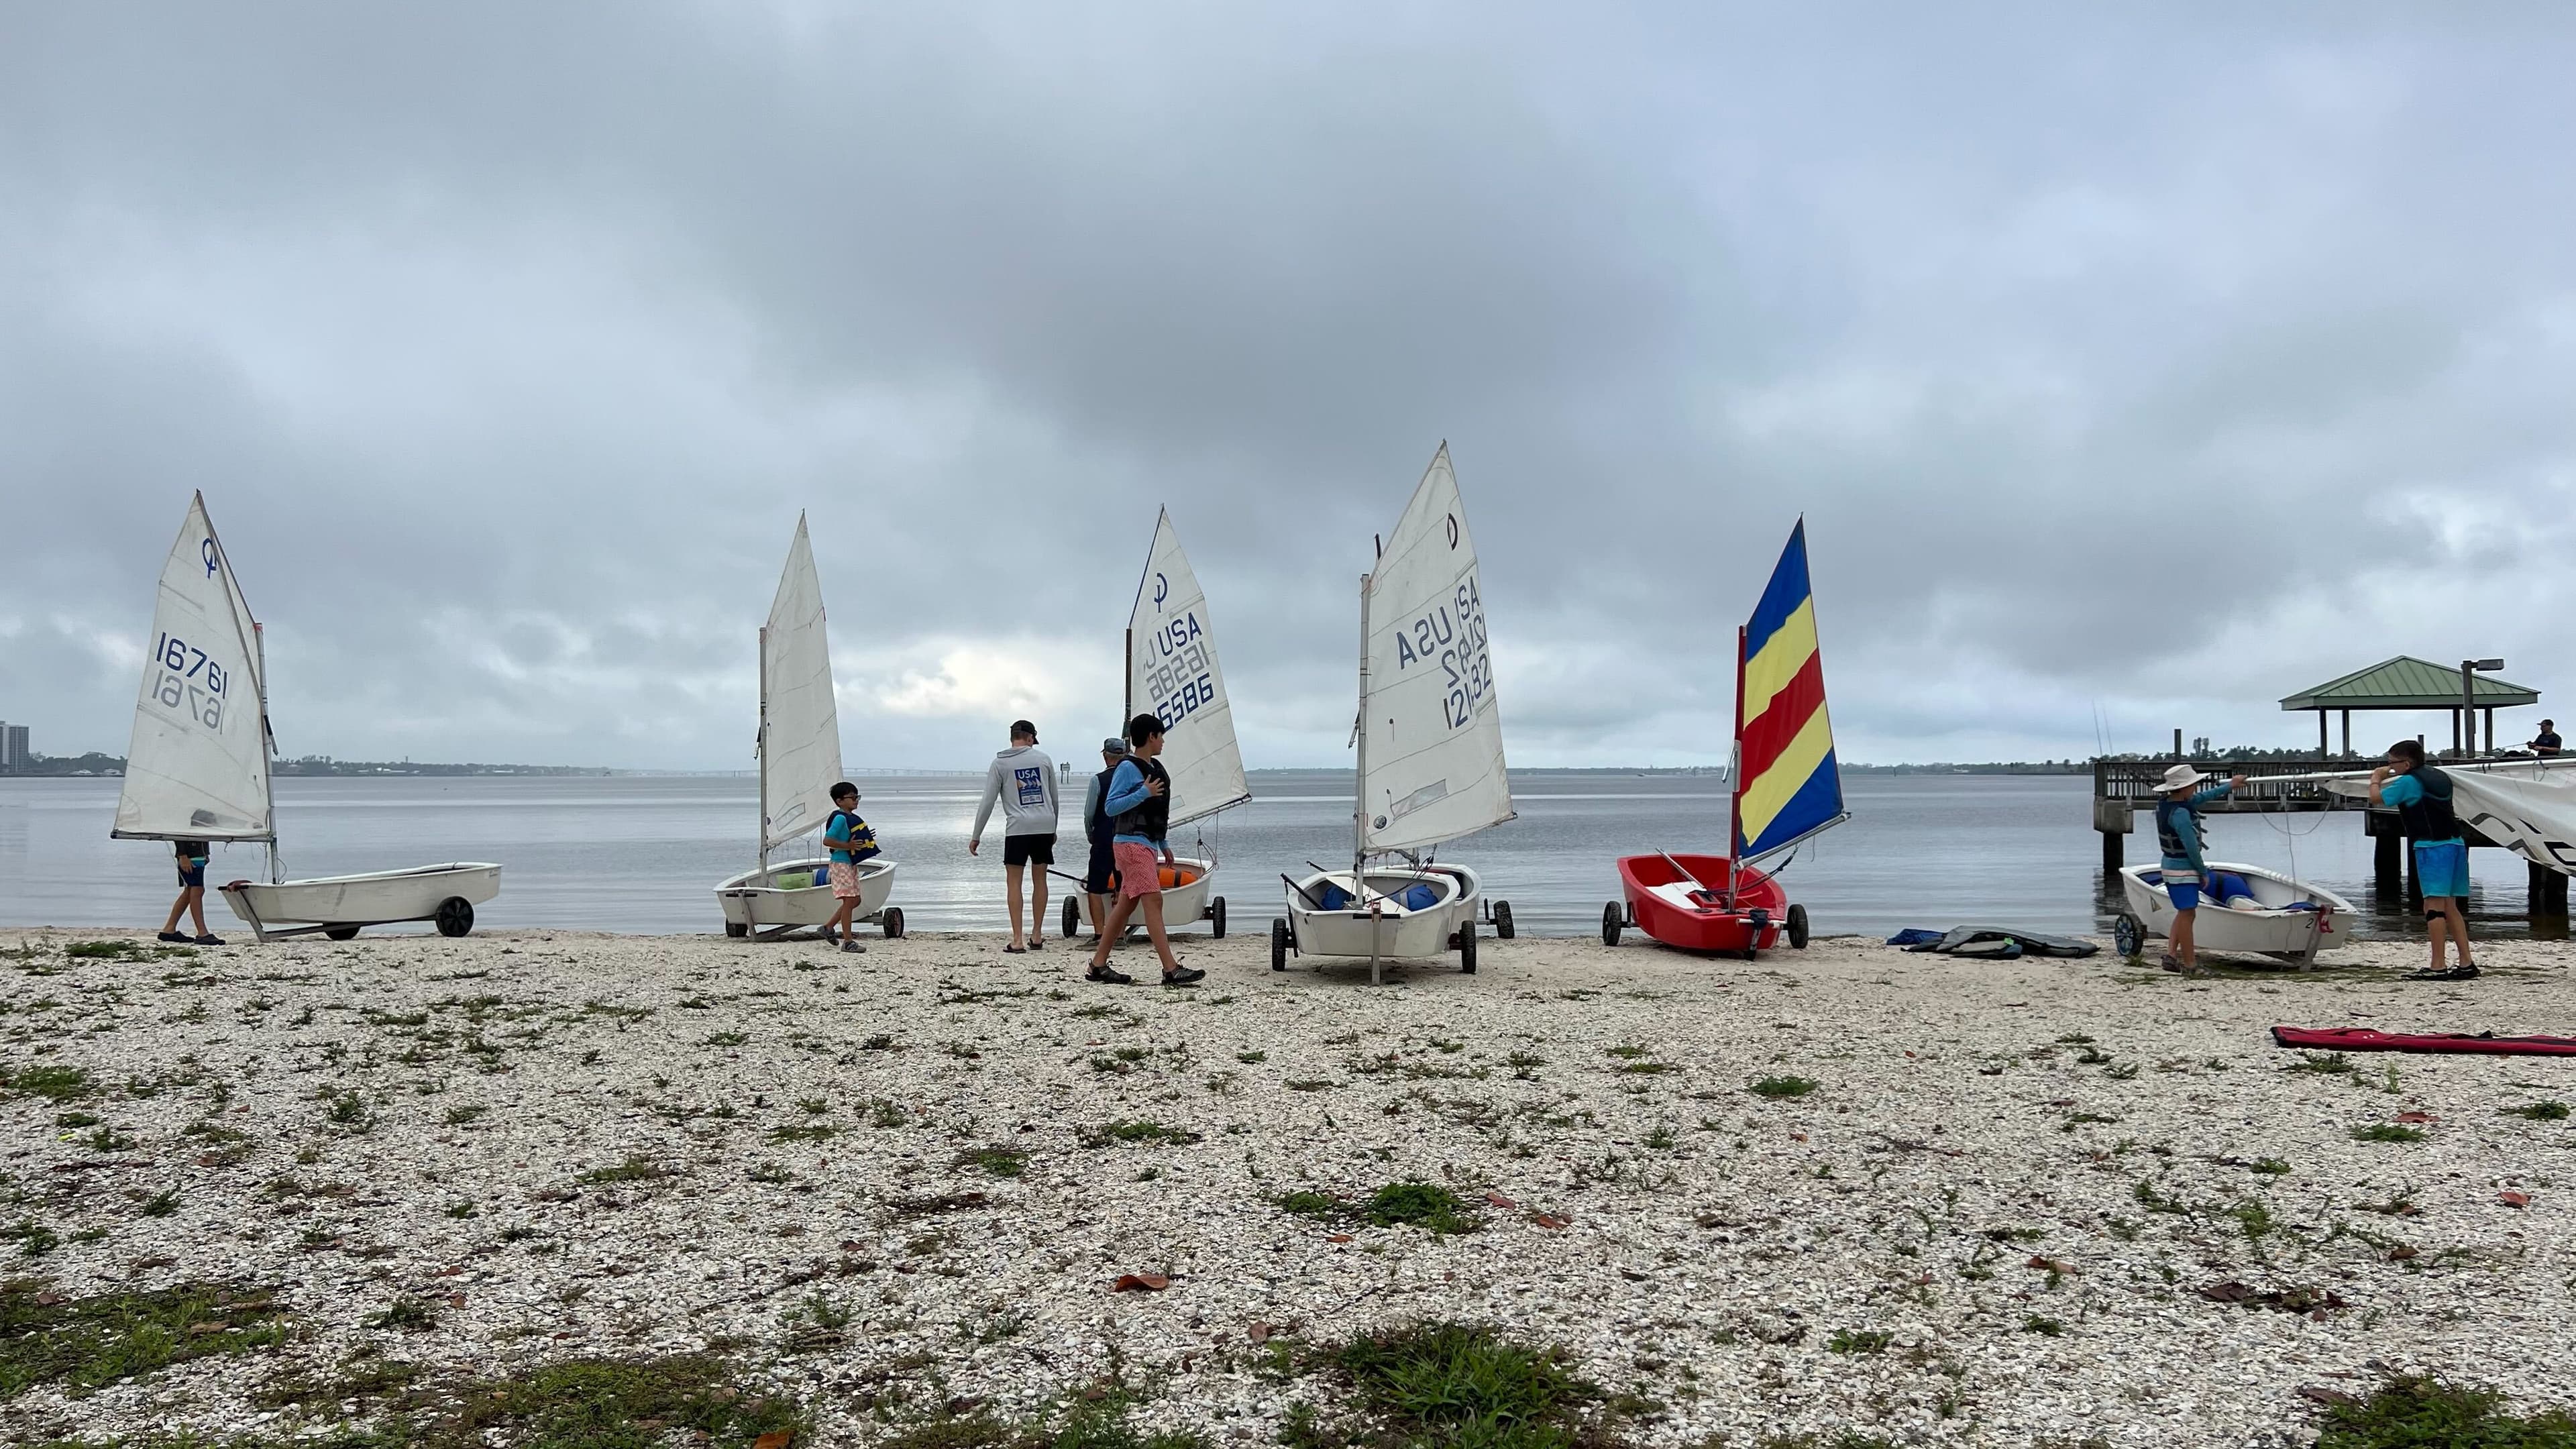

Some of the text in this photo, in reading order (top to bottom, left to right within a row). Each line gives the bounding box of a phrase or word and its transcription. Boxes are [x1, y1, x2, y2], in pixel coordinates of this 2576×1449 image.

[1454, 576, 1480, 630] SA
[1157, 612, 1202, 656] USA
[156, 632, 227, 700] 16761
[1152, 672, 1214, 732] 6586
[1017, 769, 1038, 779] USA
[2305, 918, 2314, 928] 2
